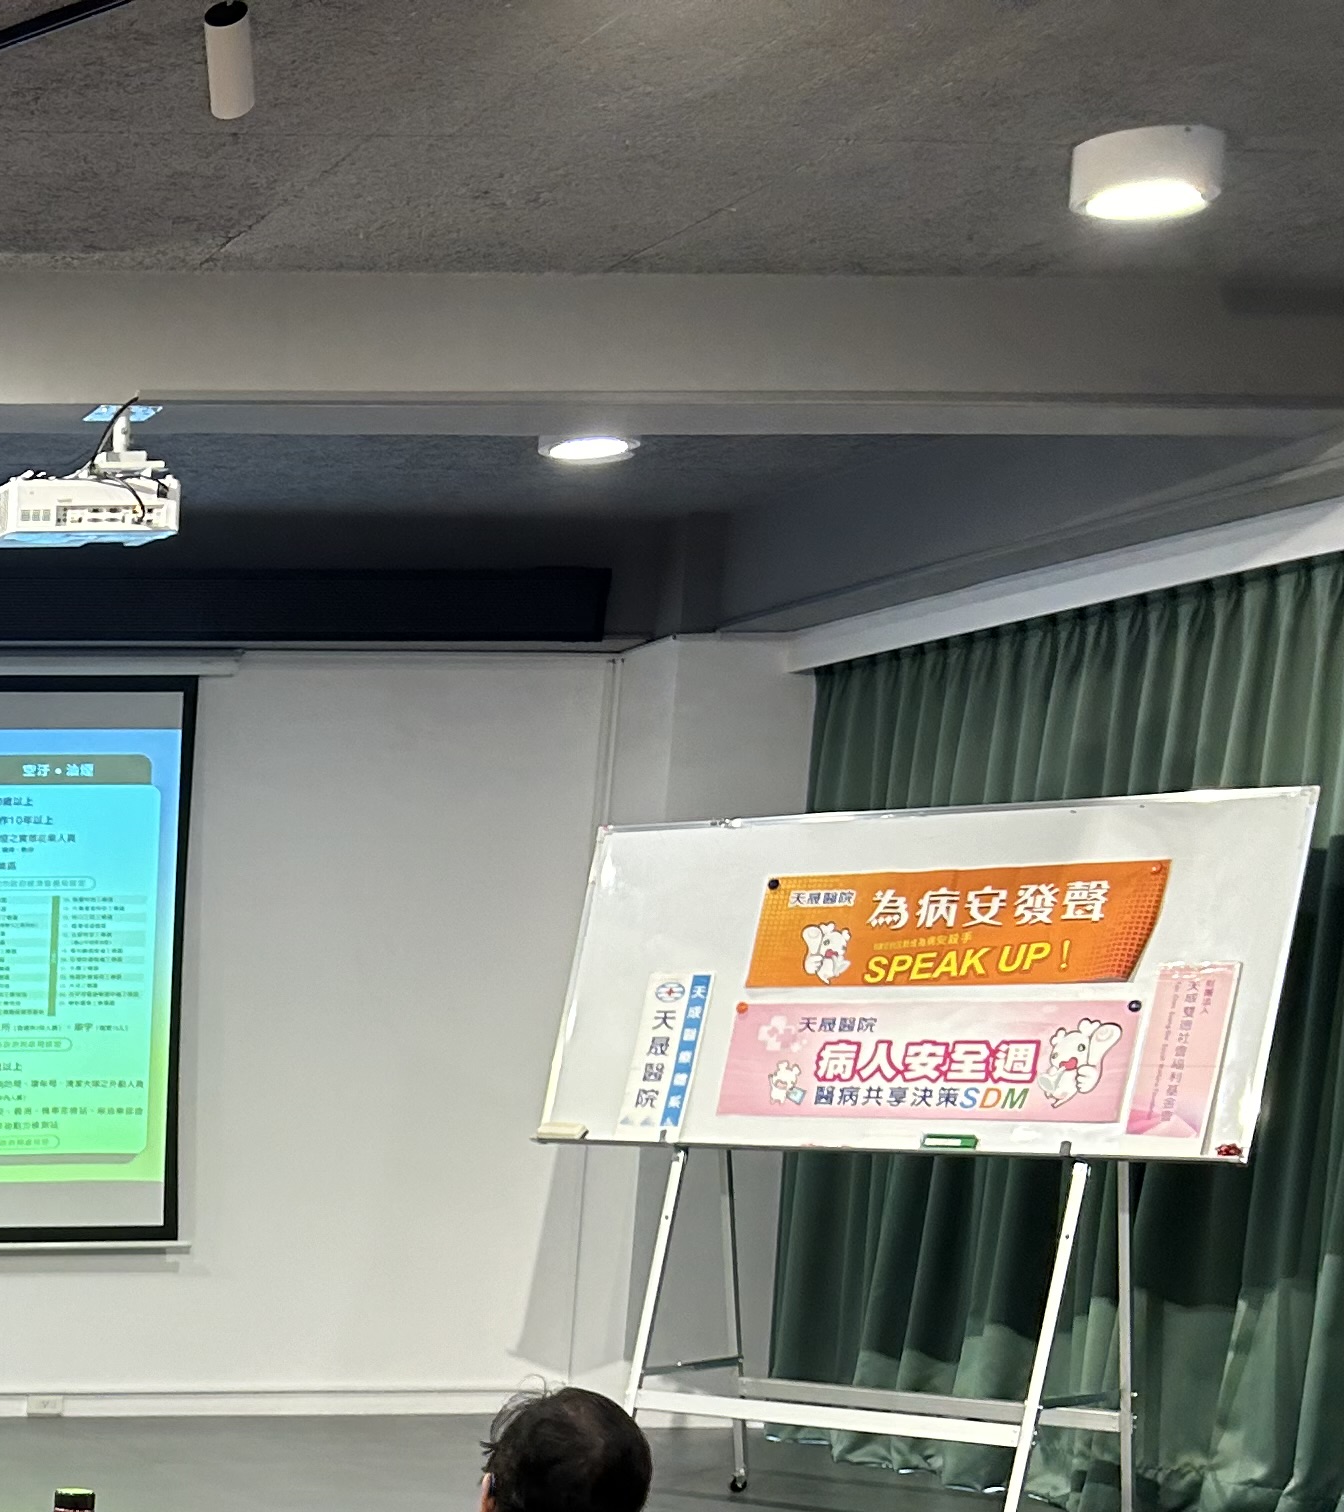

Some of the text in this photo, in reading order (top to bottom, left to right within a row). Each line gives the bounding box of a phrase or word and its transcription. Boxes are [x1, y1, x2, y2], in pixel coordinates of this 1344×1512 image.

[790, 889, 856, 907] 天晟醫院
[867, 879, 1111, 931] 為病安發聲
[863, 949, 989, 984] SPEAK
[798, 1016, 879, 1034] 天晟醫院
[635, 1009, 676, 1109] 天晟醫院
[814, 1040, 1041, 1084] 病人安全週
[813, 1086, 1029, 1110] 醫病共享決策SDM
